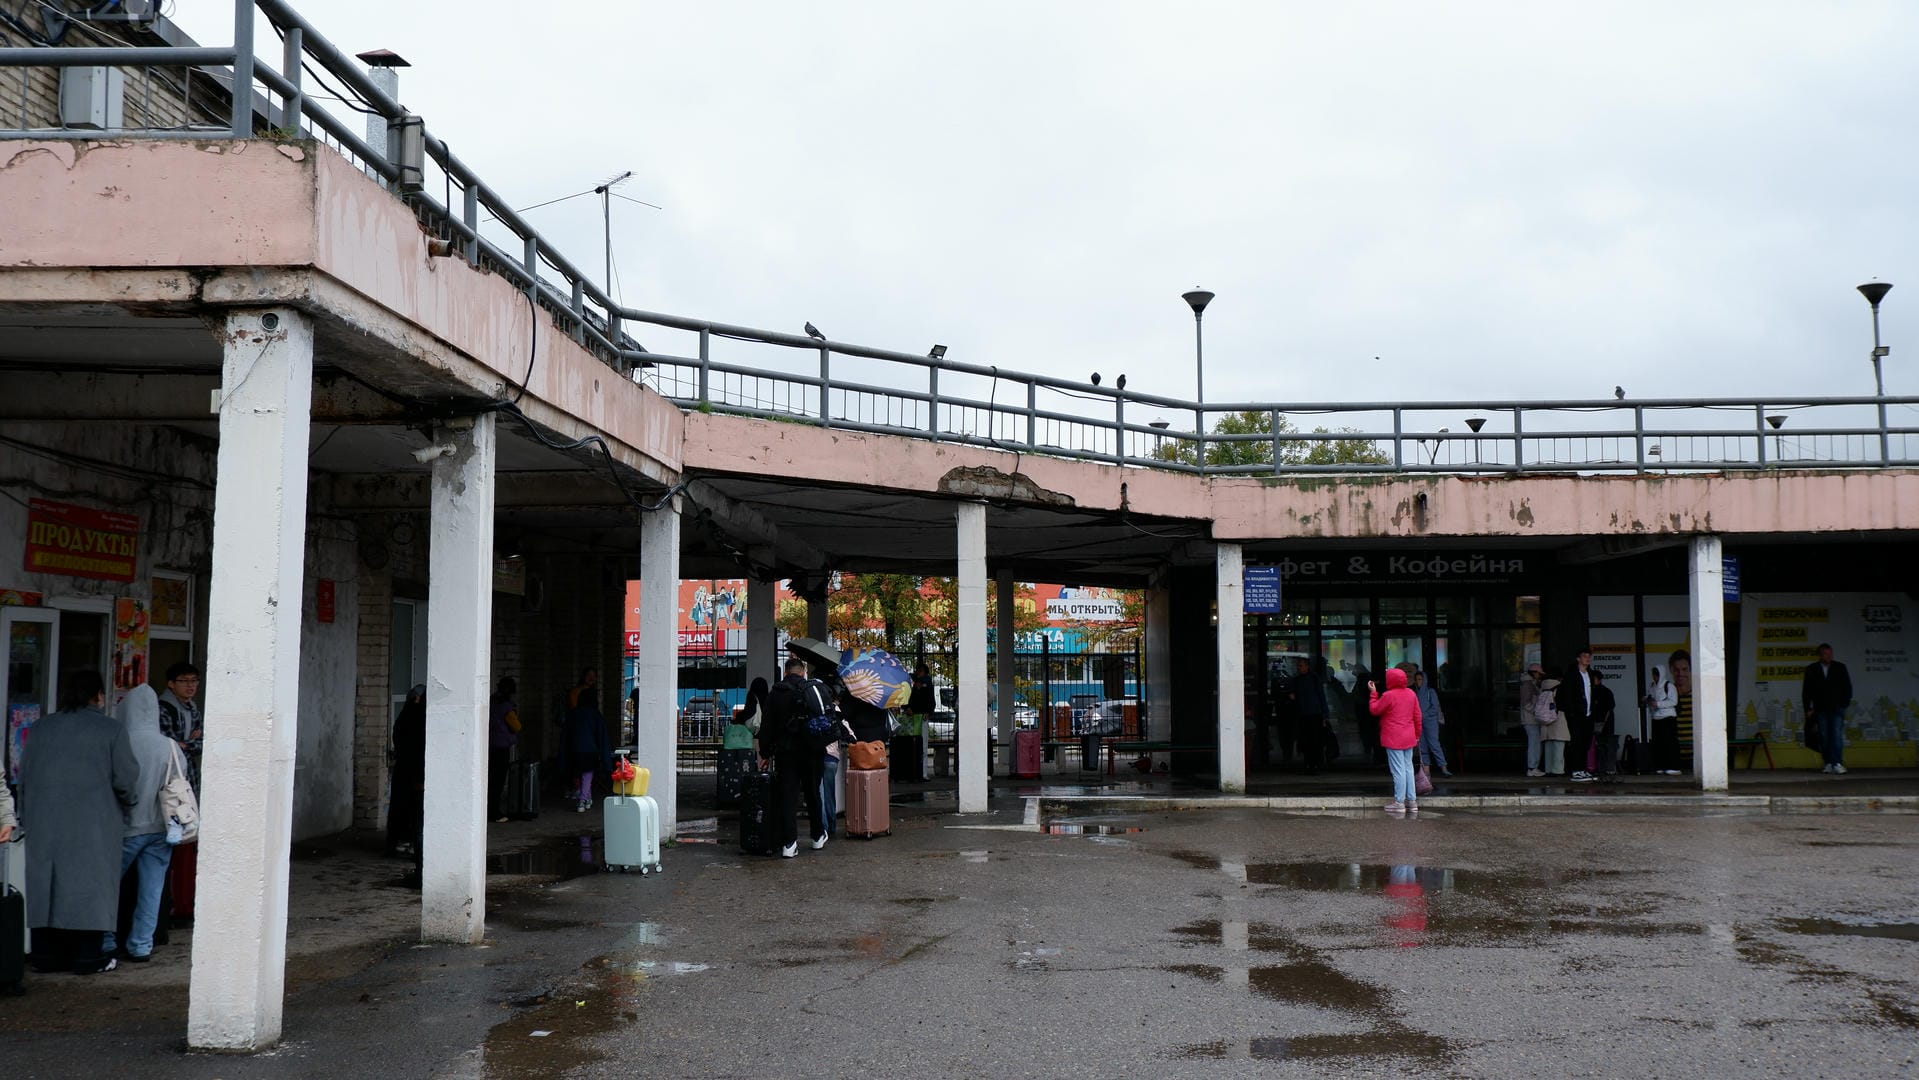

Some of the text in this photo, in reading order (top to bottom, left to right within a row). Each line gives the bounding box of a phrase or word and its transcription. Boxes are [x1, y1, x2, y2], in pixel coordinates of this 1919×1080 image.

[30, 520, 137, 558] ПРОДУКТЫ
[1346, 555, 1371, 575] &
[1389, 553, 1525, 578] Кофейня
[1048, 604, 1124, 615] МЫ ОТКРЫТЫ
[1762, 628, 1806, 638] ДОСТАВКА
[1761, 647, 1819, 657] ПО ПРИМОРЬ
